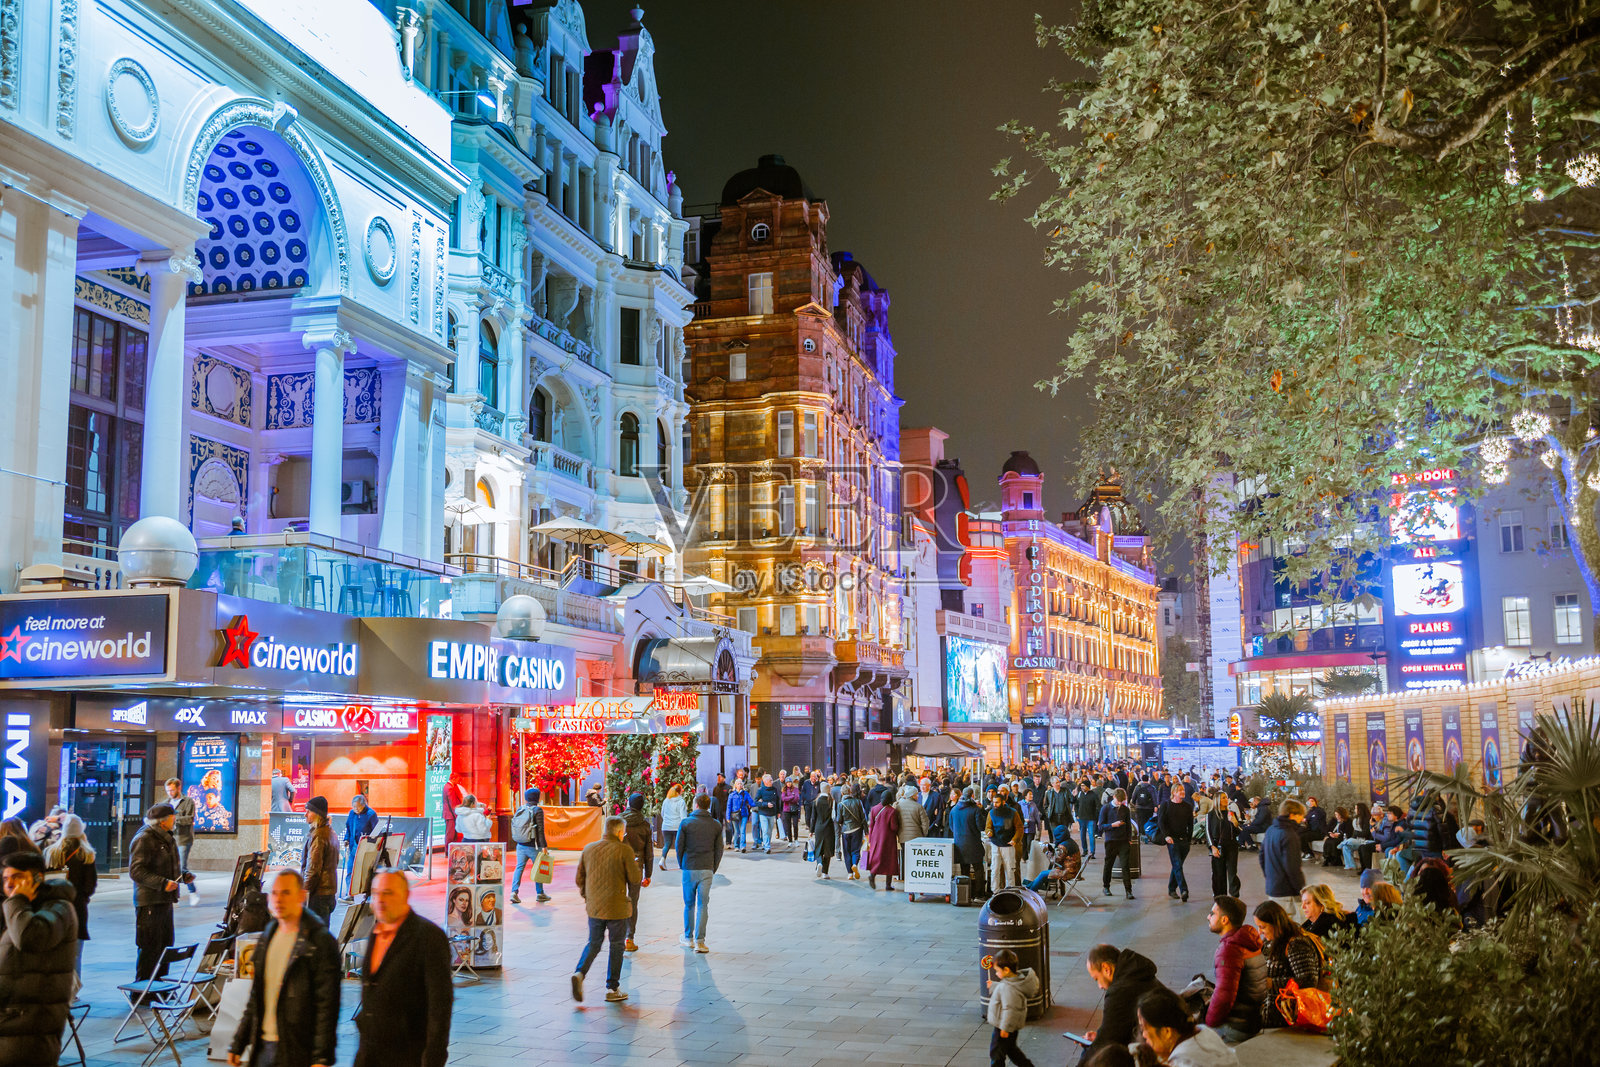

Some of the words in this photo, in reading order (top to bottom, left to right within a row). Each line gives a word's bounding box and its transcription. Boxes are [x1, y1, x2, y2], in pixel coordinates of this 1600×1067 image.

[1029, 520, 1044, 650] HIPPODROME
[25, 616, 51, 631] feel
[51, 617, 87, 630] more
[90, 616, 106, 629] at
[1410, 622, 1450, 633] PLANS
[26, 631, 151, 661] cineworld
[253, 636, 356, 676] cineworld
[1014, 657, 1056, 668] CASINO
[431, 641, 498, 682] EMPIRE
[505, 655, 565, 690] CASINO
[653, 688, 698, 710] Horizons
[175, 706, 206, 726] 4DX
[232, 711, 267, 725] IMAX
[295, 710, 337, 727] CASINO
[379, 712, 409, 728] POKER
[666, 715, 690, 726] CASINO
[551, 720, 605, 732] CASINO
[192, 745, 227, 754] BLITZ
[3, 714, 30, 820] IMA
[433, 767, 445, 775] PLAY
[431, 775, 447, 783] ONLINE
[912, 848, 935, 856] TAKE
[911, 871, 944, 879] QURAN
